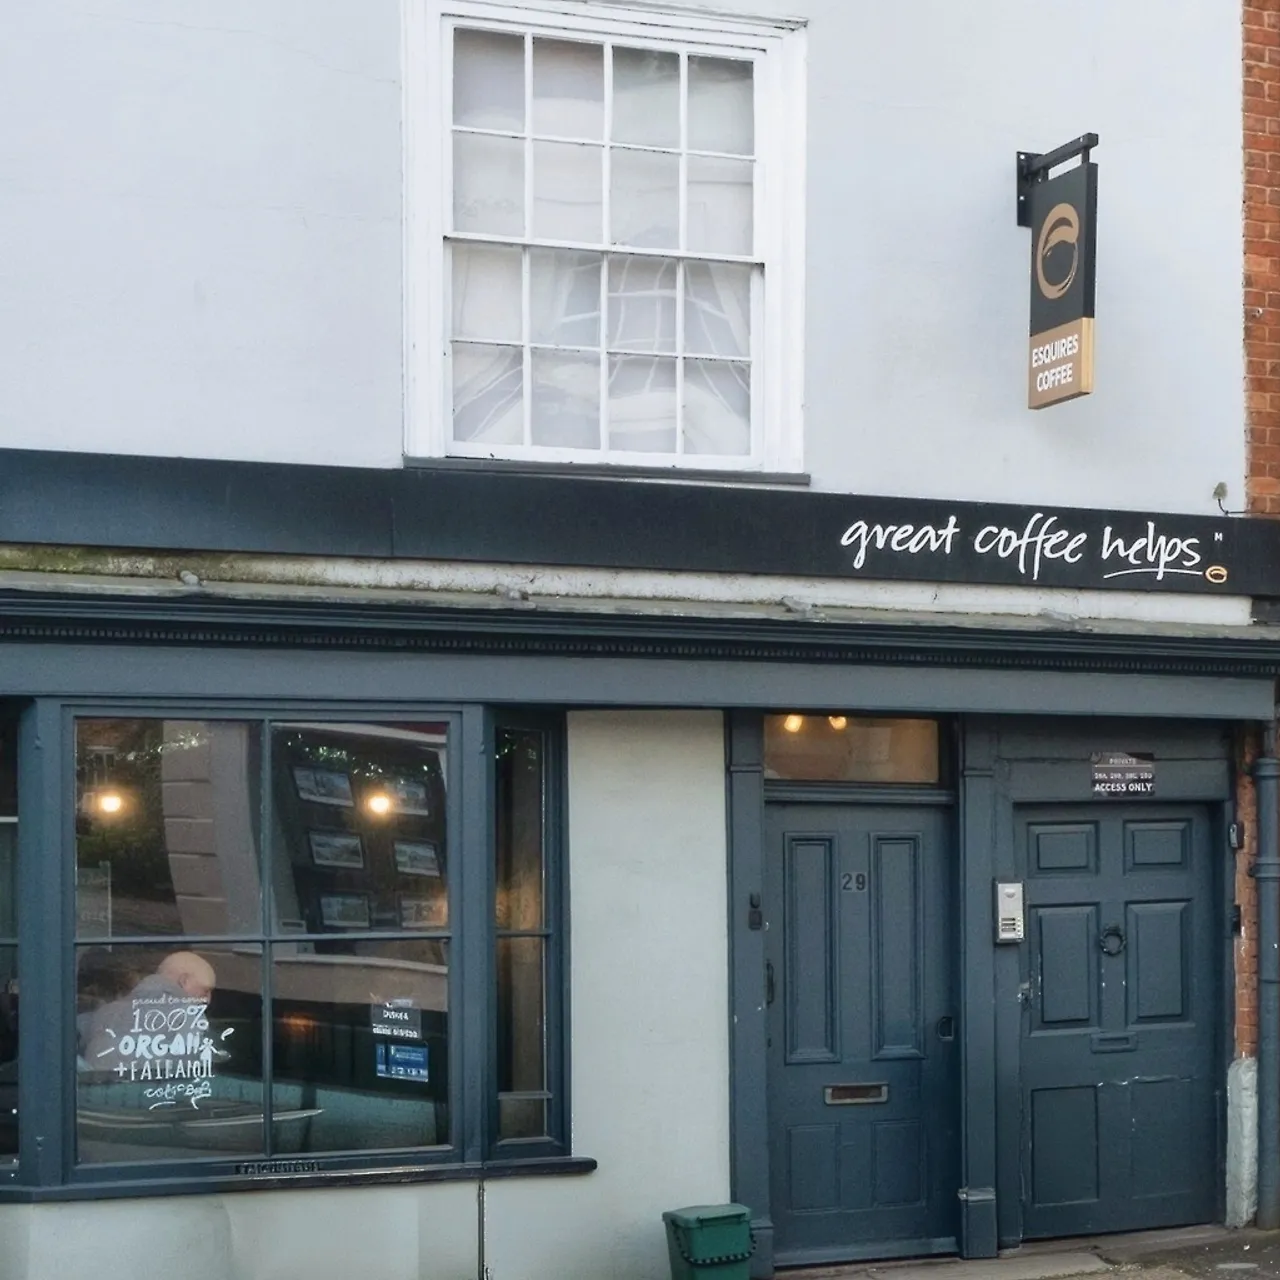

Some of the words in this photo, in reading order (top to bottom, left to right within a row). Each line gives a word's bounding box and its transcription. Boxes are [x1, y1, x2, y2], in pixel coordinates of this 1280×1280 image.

[1032, 333, 1079, 368] ESQUIRES
[1037, 362, 1073, 392] COFFEE
[840, 514, 961, 569] great
[973, 512, 1088, 581] coffee
[1100, 521, 1202, 581] helps
[1094, 783, 1127, 792] ACCESS
[1128, 783, 1153, 792] ONLY
[842, 872, 866, 891] 29
[132, 993, 166, 1008] proud
[169, 996, 177, 1005] to
[130, 1004, 209, 1032] 100%
